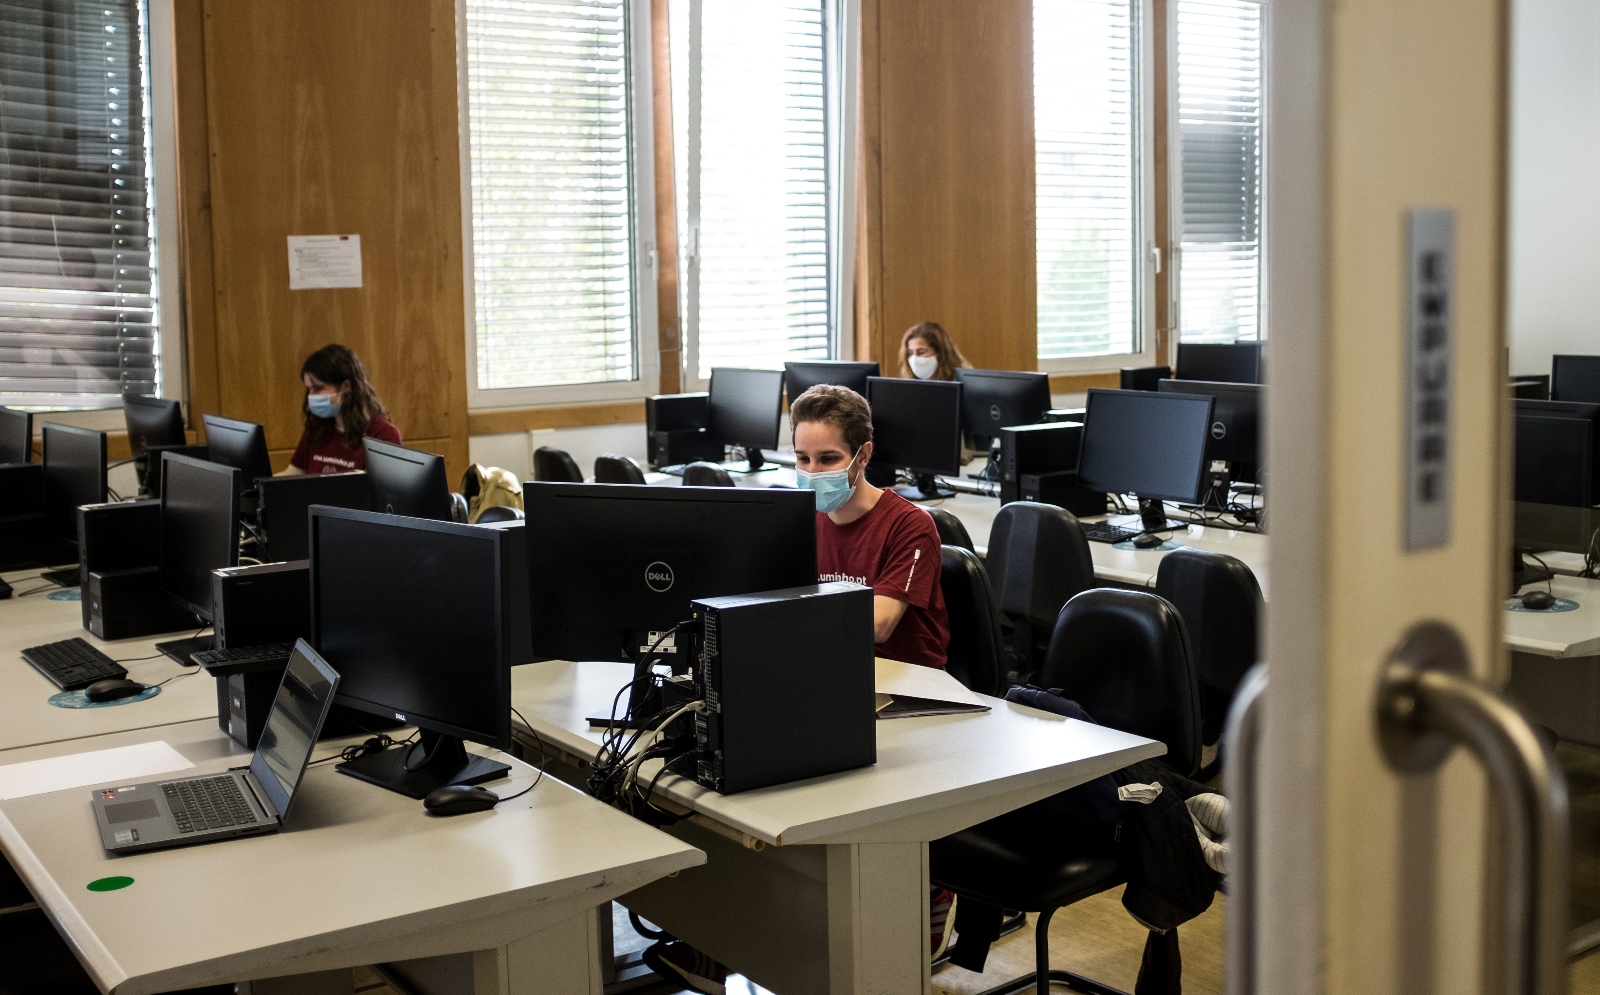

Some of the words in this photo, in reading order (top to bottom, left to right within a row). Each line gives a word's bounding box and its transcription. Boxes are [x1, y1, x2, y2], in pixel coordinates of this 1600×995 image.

[648, 572, 671, 581] DELL
[817, 571, 867, 587] .uminho.pt
[395, 712, 406, 721] DELL
